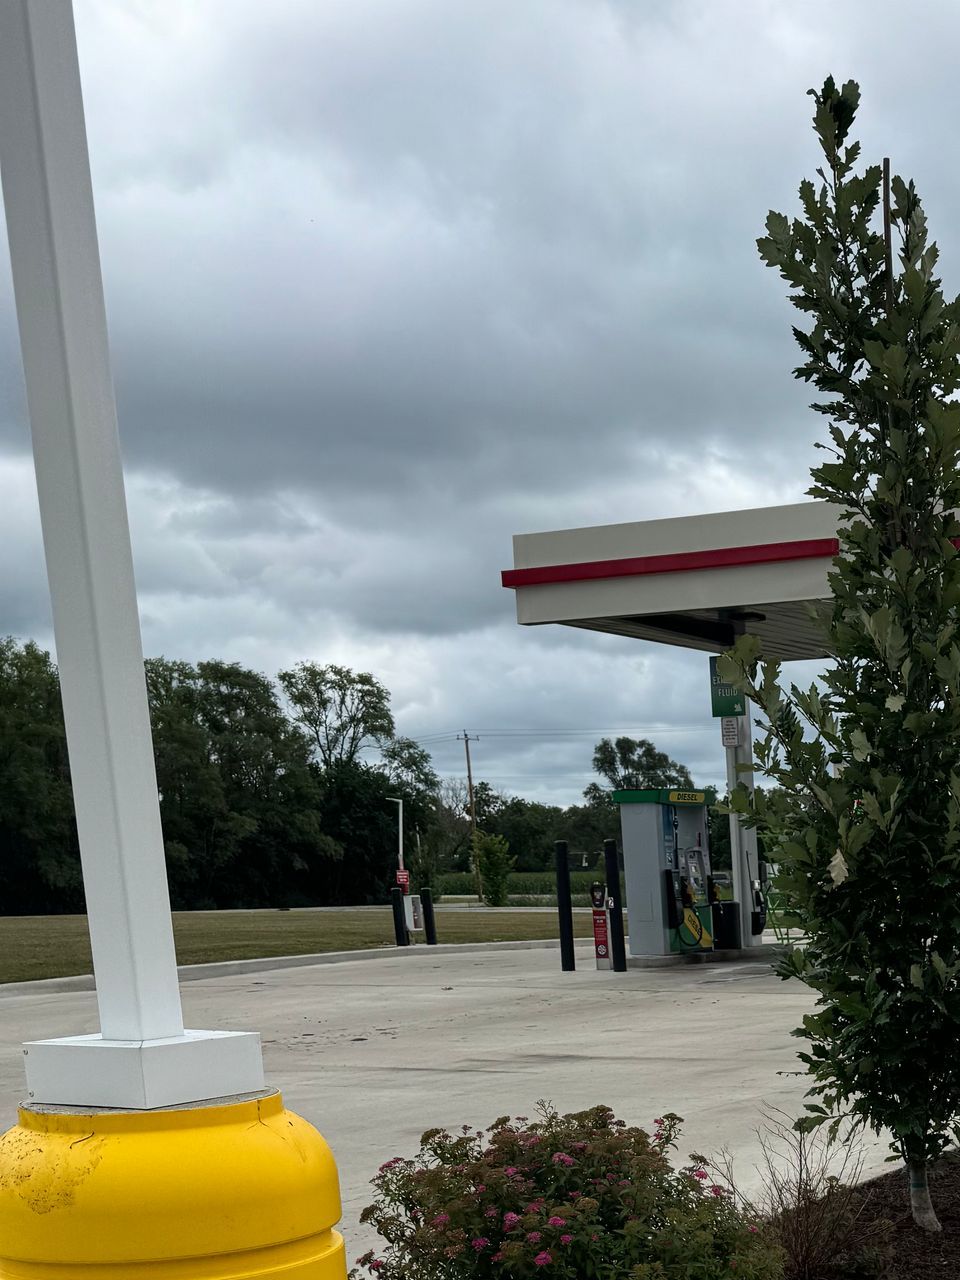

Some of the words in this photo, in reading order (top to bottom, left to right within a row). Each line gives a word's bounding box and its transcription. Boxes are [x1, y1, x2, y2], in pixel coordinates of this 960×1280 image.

[718, 688, 738, 697] FLUID
[676, 793, 698, 801] DIESEL
[687, 914, 702, 936] DIESE
